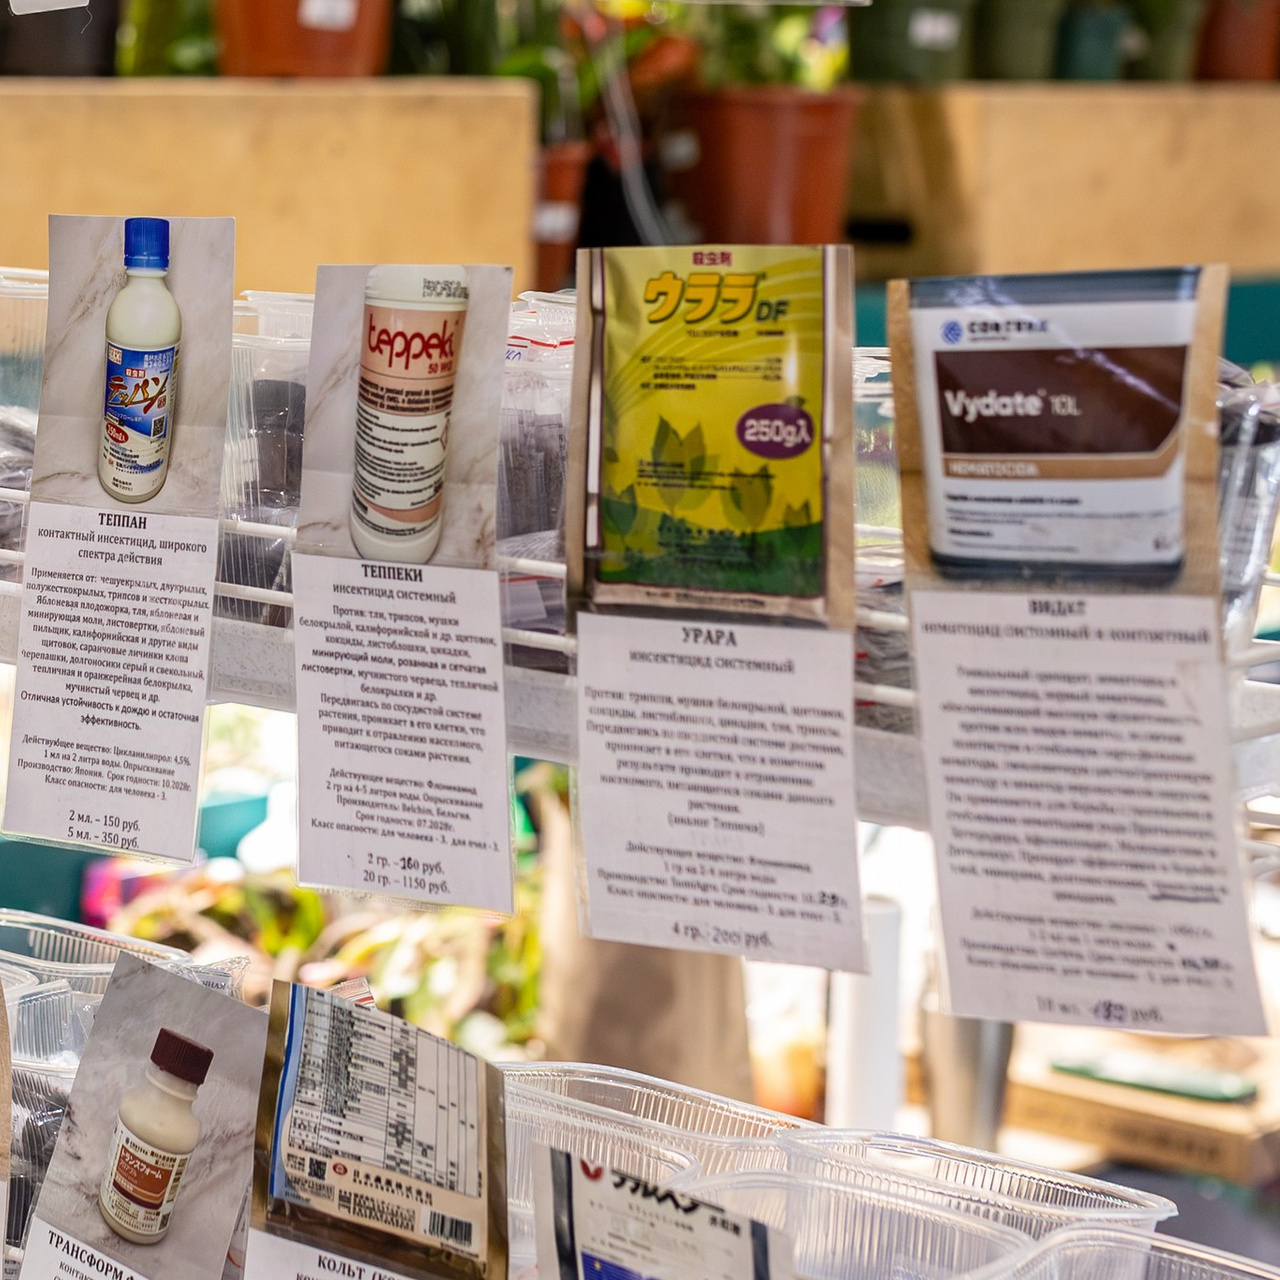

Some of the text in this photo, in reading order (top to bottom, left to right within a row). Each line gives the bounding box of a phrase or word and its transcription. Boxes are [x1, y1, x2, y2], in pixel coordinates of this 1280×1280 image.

[644, 271, 789, 324] ウララ DF
[368, 313, 454, 370] teppeki
[98, 512, 146, 529] ТЕППАН
[38, 528, 206, 553] контактный инсектицид, широкого
[78, 549, 162, 565] спектра действия
[361, 564, 422, 582] ТЕППЕКИ
[333, 584, 456, 604] инсектицид системный
[682, 627, 737, 646] УРАРА
[77, 812, 93, 824] мл.
[103, 815, 120, 828] 150
[122, 819, 141, 832] руб.
[318, 1255, 365, 1280] КОЛЬТ
